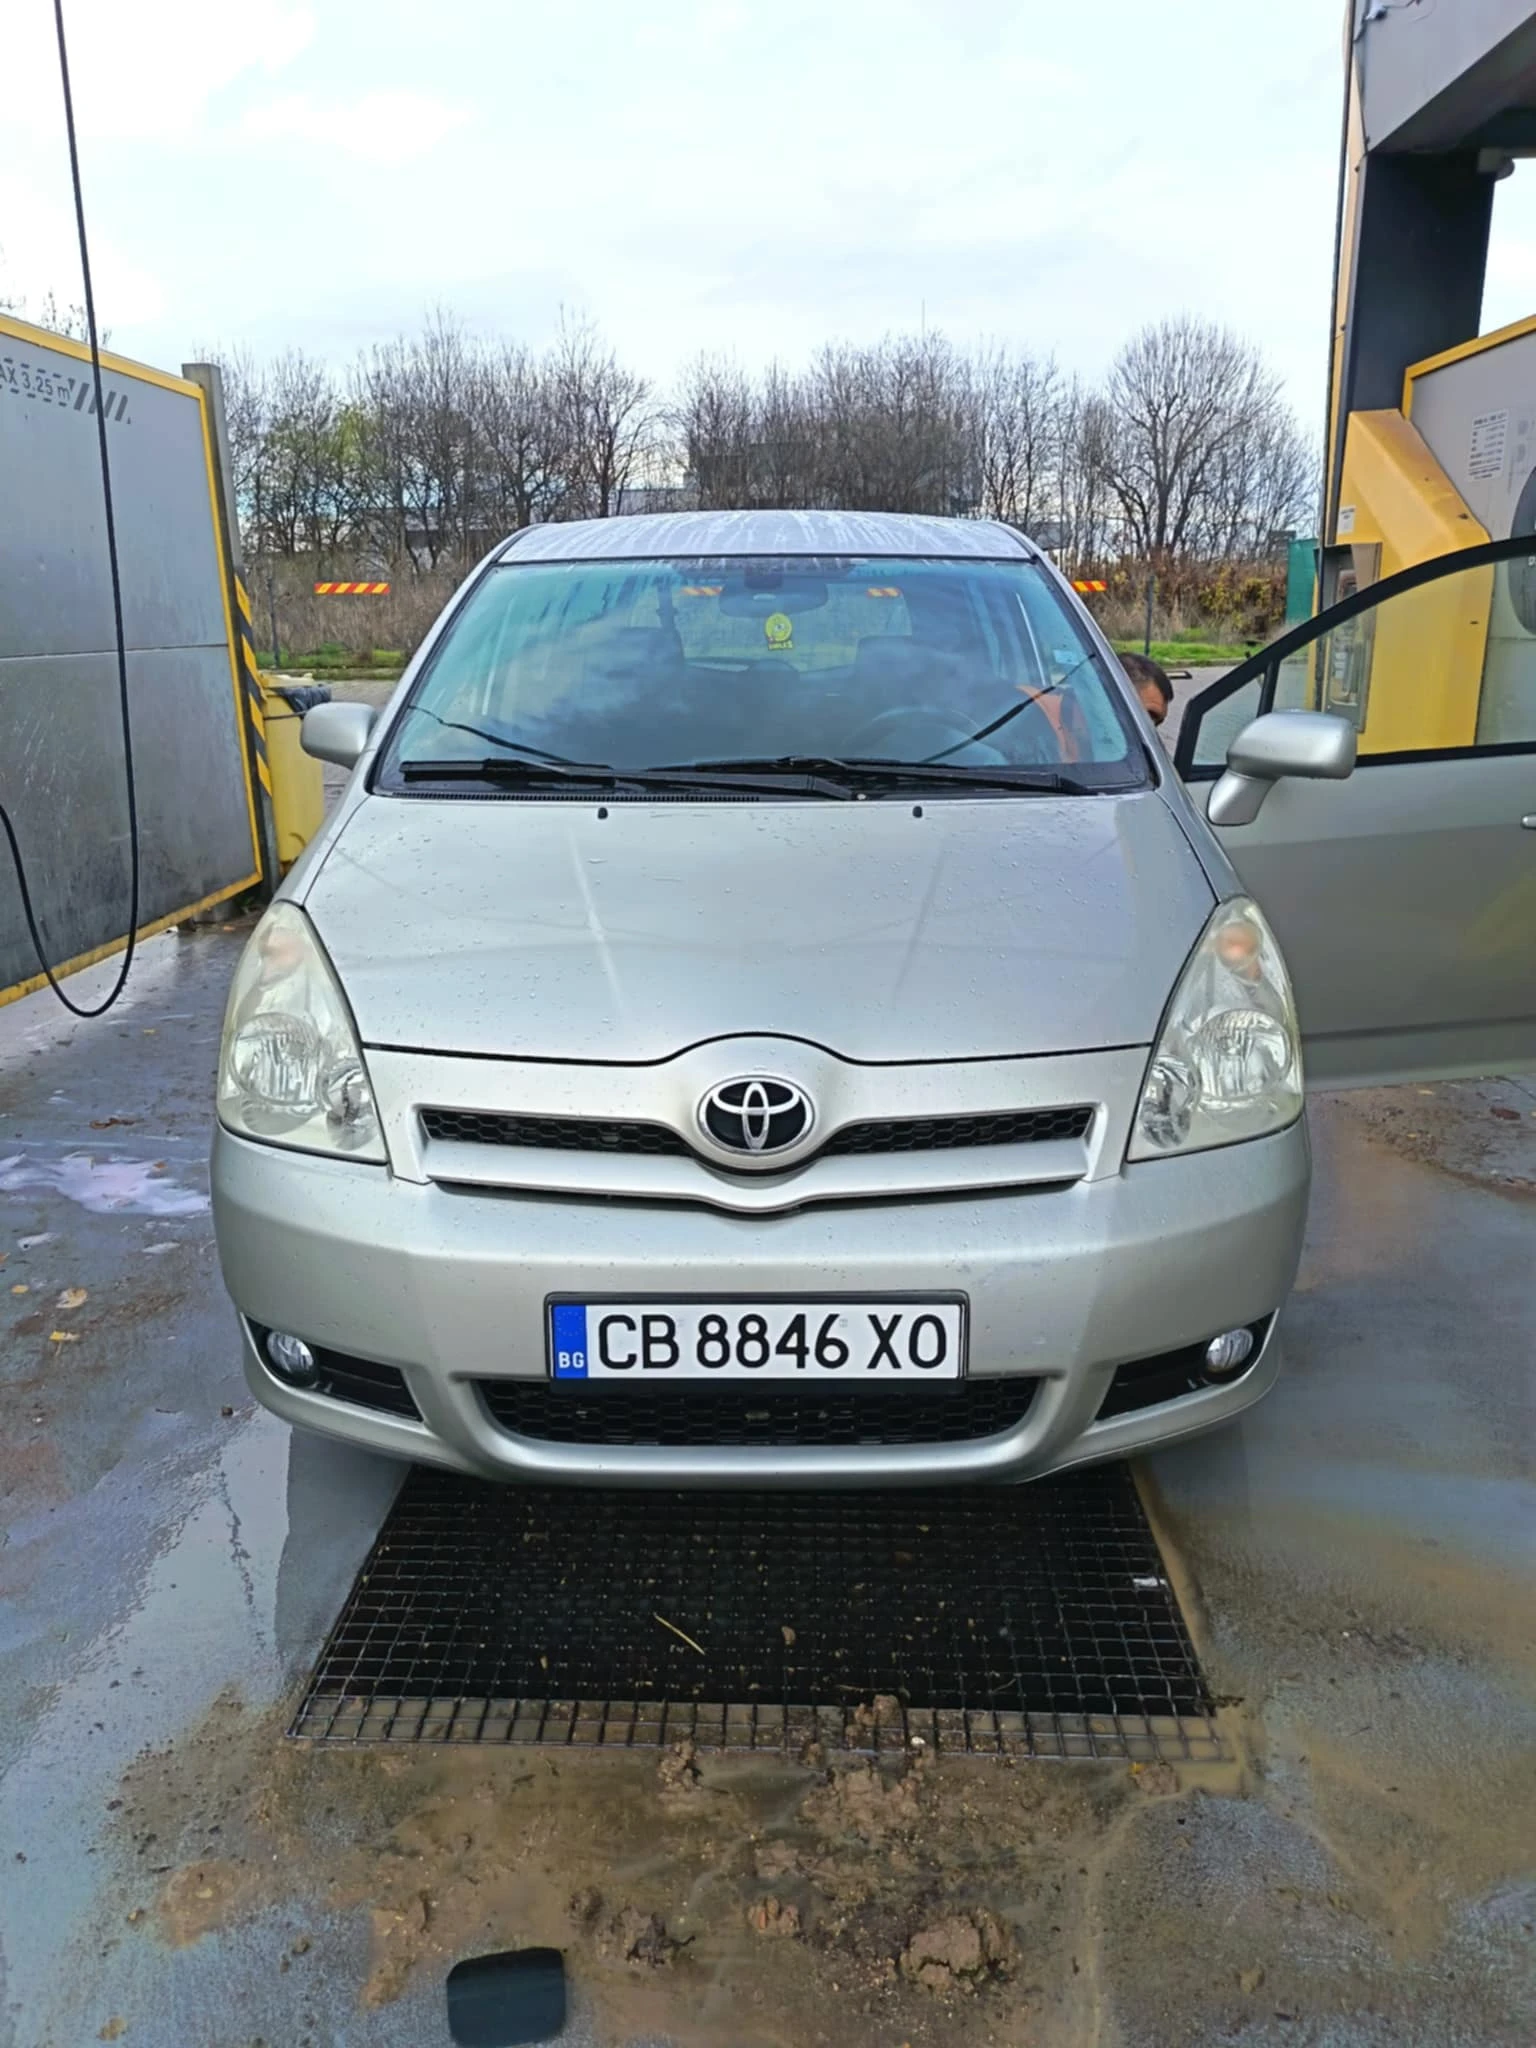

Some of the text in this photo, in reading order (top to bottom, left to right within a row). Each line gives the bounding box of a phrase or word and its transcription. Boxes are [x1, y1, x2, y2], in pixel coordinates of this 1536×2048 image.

[21, 371, 53, 396] 3.25
[599, 1314, 947, 1370] CB 8846 XO
[558, 1351, 585, 1369] BG
